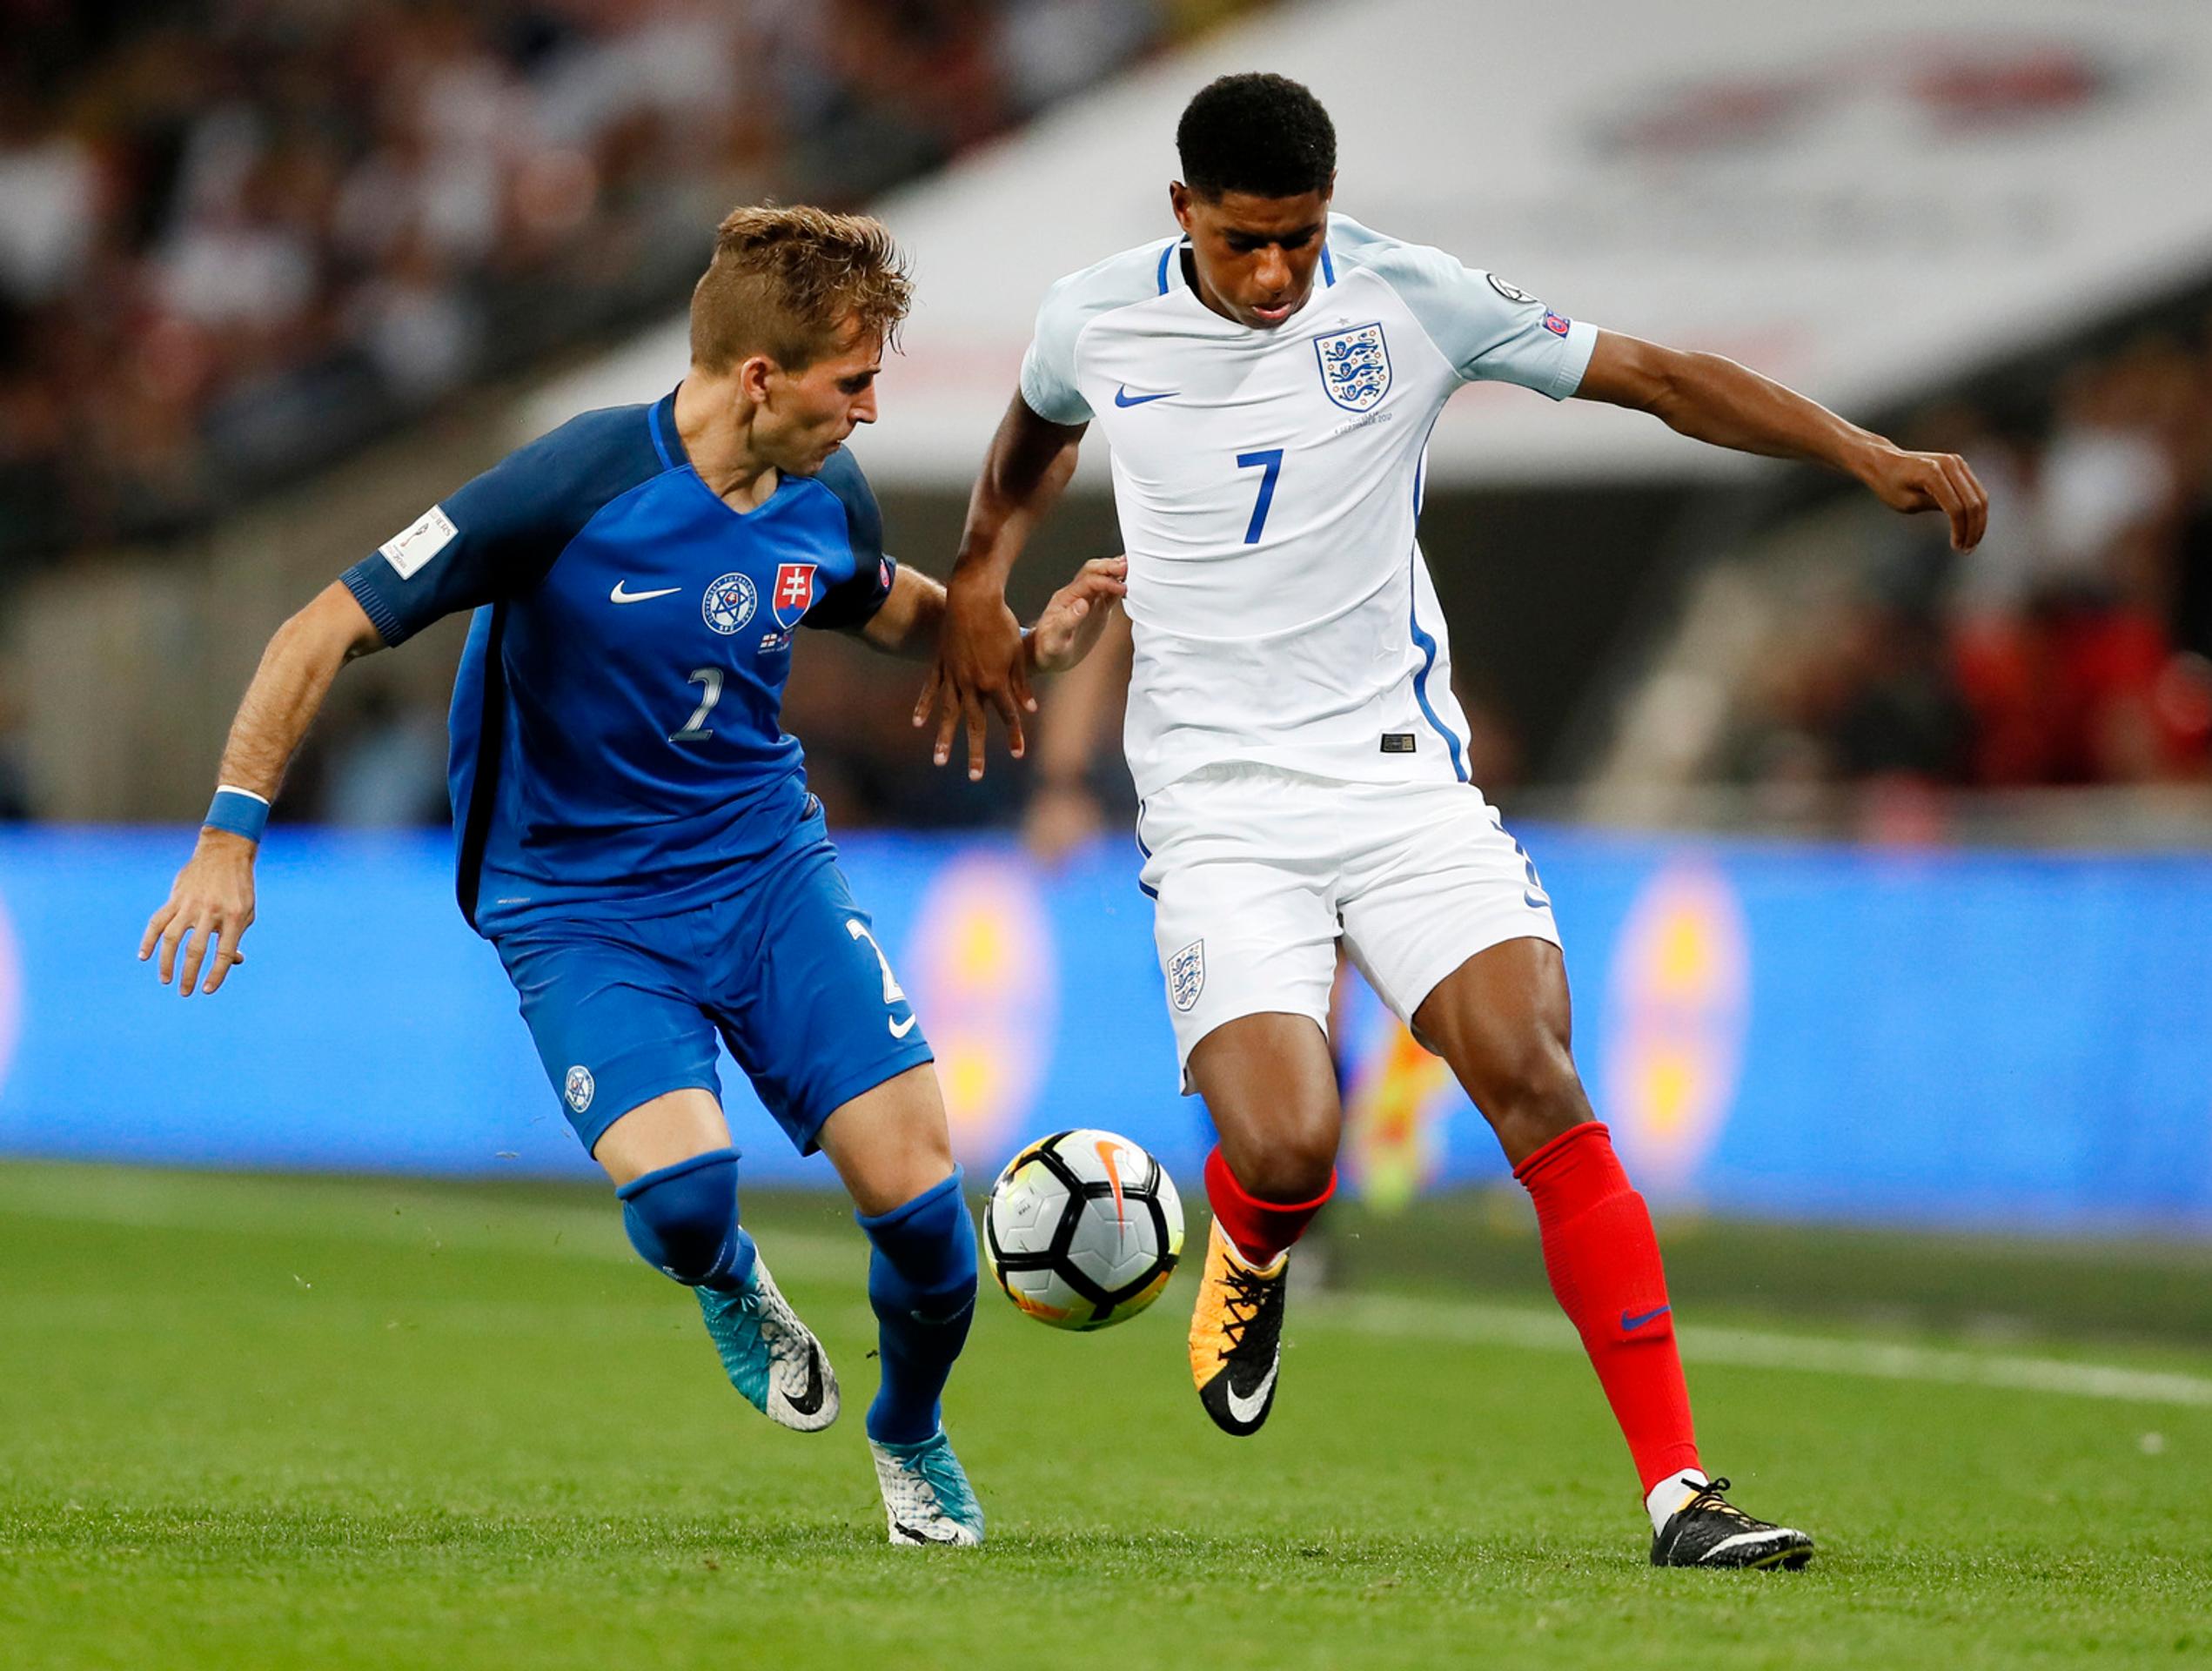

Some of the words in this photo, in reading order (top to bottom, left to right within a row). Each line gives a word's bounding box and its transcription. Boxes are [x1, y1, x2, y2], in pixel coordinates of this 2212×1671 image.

[1237, 449, 1284, 544] 7
[668, 667, 724, 742] 2
[846, 919, 906, 1004] 2
